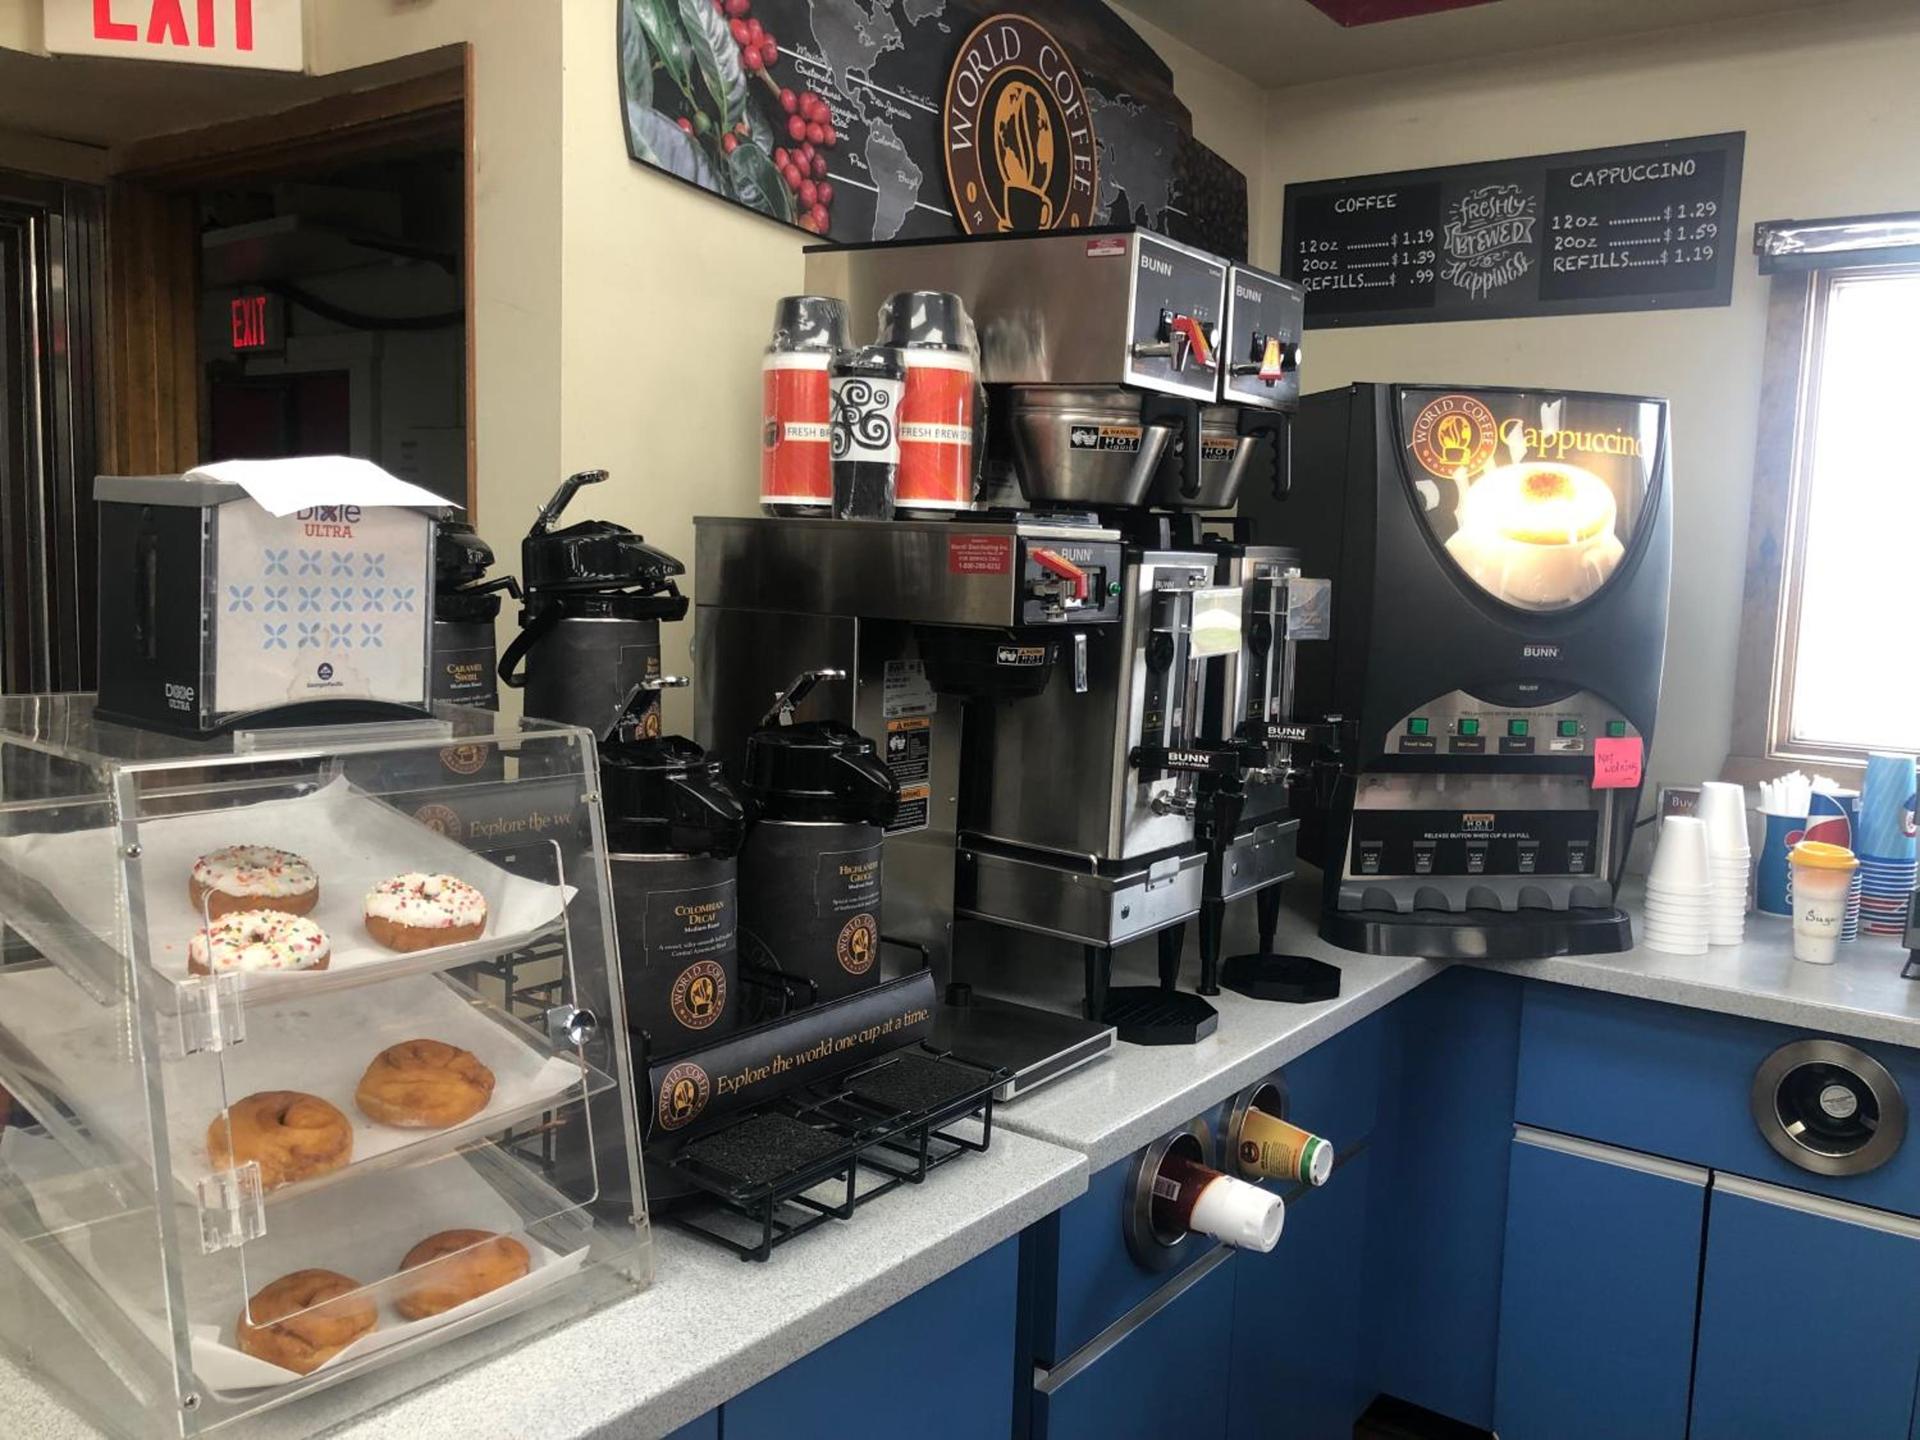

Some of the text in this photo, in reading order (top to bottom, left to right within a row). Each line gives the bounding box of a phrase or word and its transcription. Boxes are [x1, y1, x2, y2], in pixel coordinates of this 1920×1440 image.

[952, 26, 1092, 196] WORLD COFFEE
[1570, 159, 1696, 188] CAPPUCCINO
[1335, 193, 1398, 214] COFFEE
[1552, 215, 1599, 230] 12oz
[1677, 202, 1717, 219] 1.29
[1300, 240, 1339, 254] 12oz
[1402, 229, 1434, 245] 1.19
[1554, 237, 1599, 251] 20oz
[1677, 224, 1718, 241] 1.59
[1302, 258, 1339, 272] 20oz
[1402, 250, 1436, 266] 1.39
[1675, 246, 1714, 264] 1.19
[1141, 255, 1173, 278] BUNN
[1236, 285, 1262, 303] BUNN
[232, 297, 266, 347] EXIT
[787, 428, 816, 437] FRESH
[901, 427, 932, 437] FRESH
[1415, 399, 1494, 445] WORLD COFFEE
[1205, 448, 1231, 456] HOT
[304, 523, 354, 538] ULTRA
[1061, 547, 1092, 562] BUNN
[1524, 647, 1558, 658] BUNN
[168, 699, 190, 711] ULTRA
[1267, 726, 1306, 737] BUNN
[1168, 752, 1209, 763] BUNN
[470, 817, 527, 839] Explore
[529, 811, 550, 832] the
[674, 966, 702, 1006] WORLD
[717, 1008, 930, 1096] Explore the world one cup at a time.
